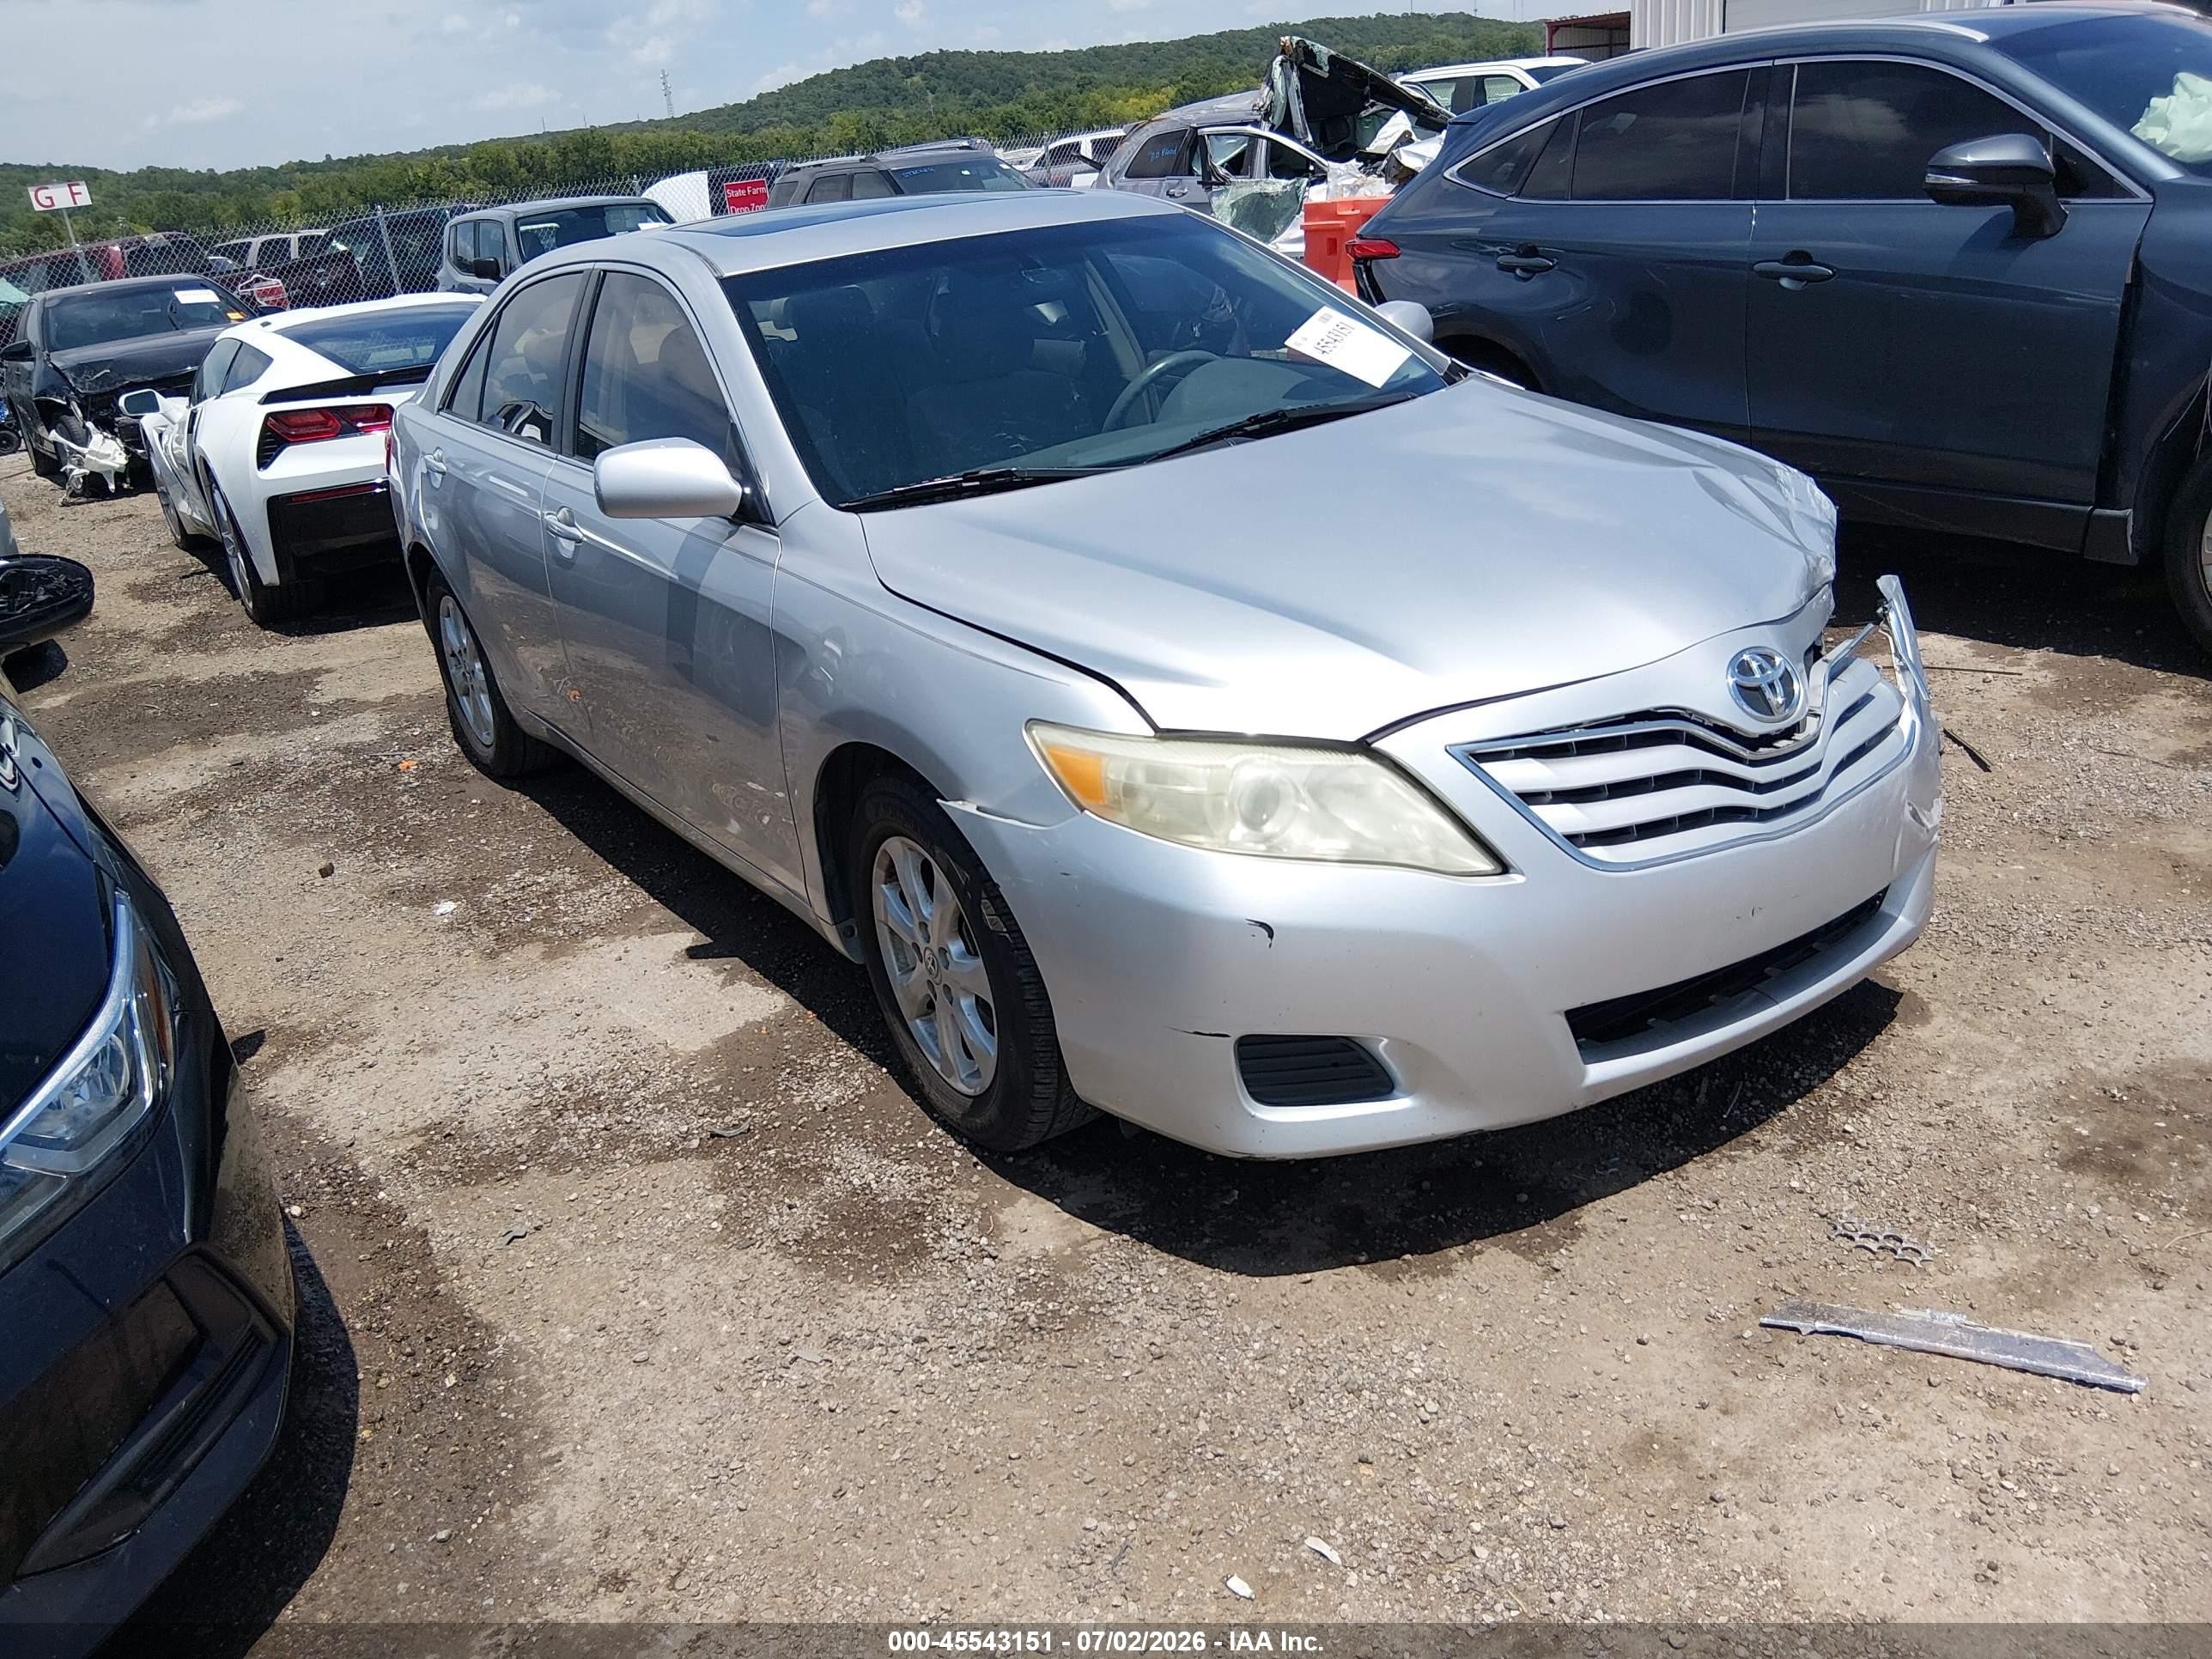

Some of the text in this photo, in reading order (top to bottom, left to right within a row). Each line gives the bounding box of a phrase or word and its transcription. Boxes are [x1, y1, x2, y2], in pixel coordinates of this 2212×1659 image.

[34, 183, 82, 208] G F
[726, 185, 767, 198] State Farm
[750, 203, 766, 212] Zon
